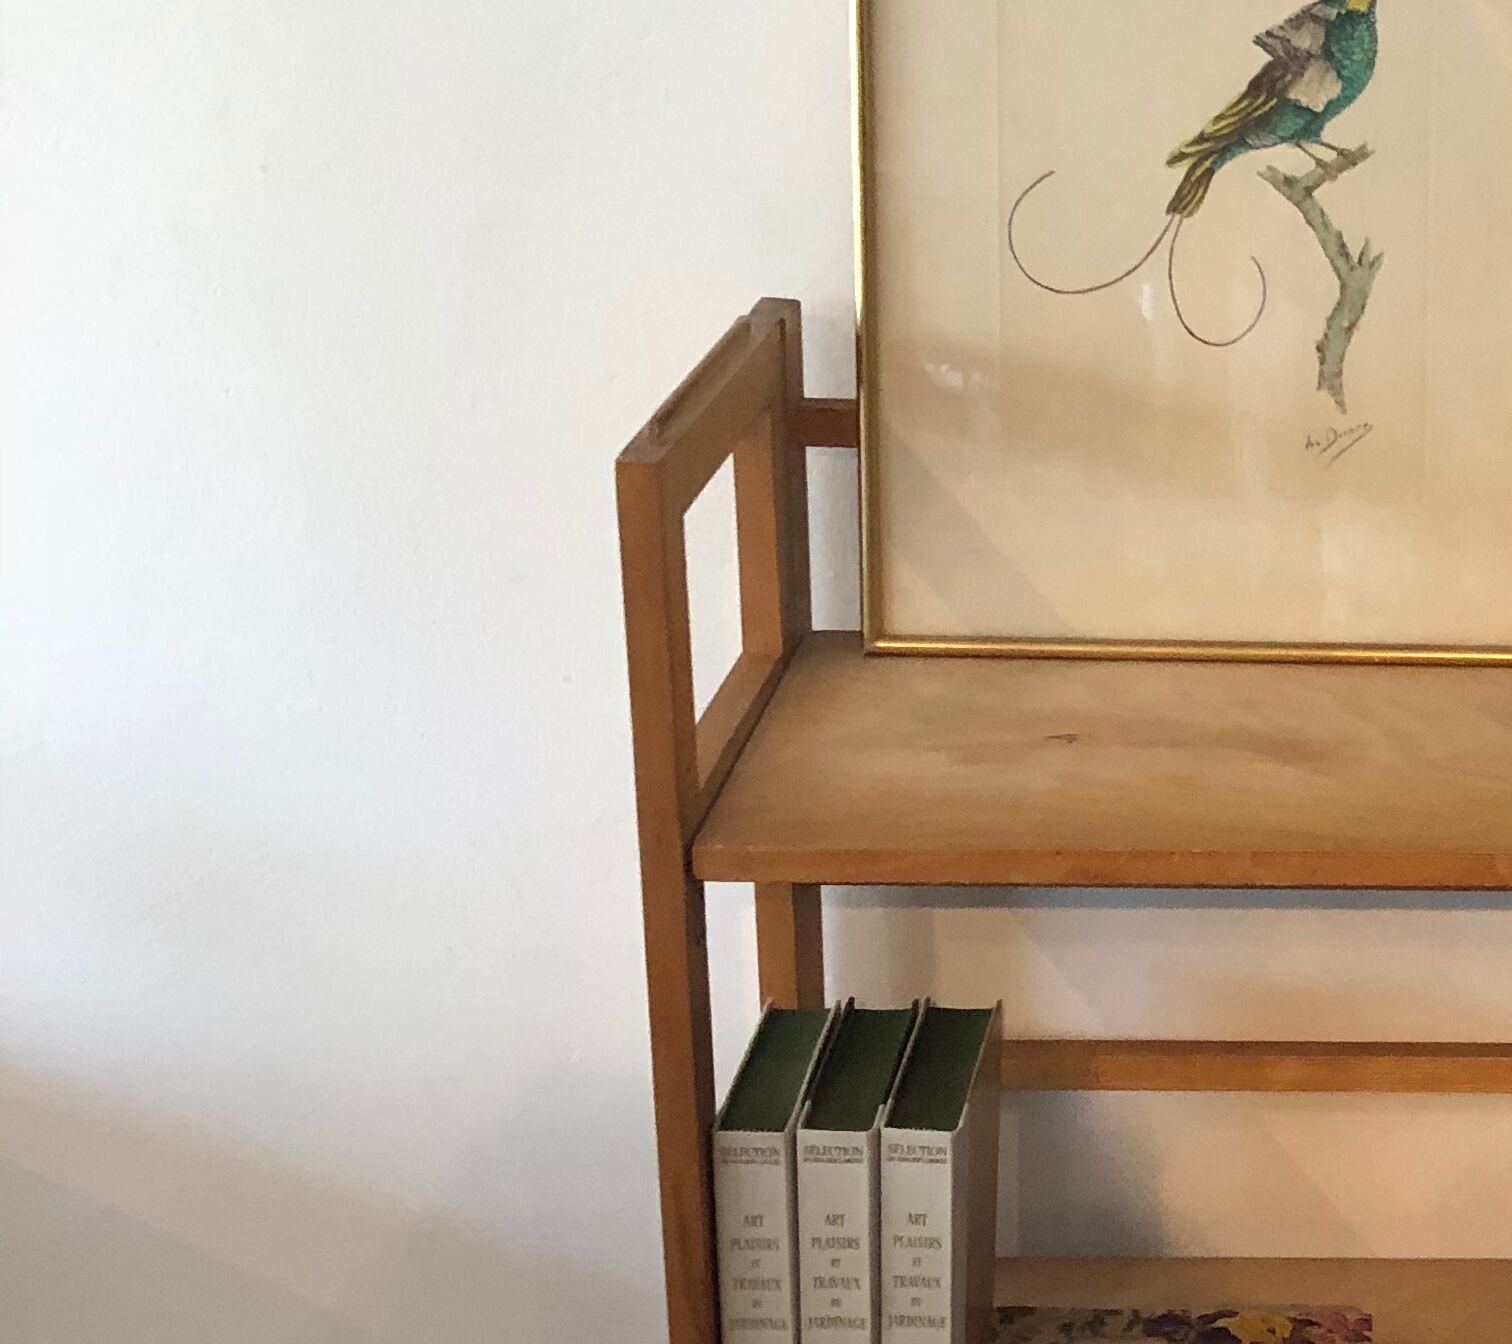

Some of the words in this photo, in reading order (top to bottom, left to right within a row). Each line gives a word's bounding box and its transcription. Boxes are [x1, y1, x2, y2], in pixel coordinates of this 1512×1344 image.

[742, 1214, 764, 1228] ART
[824, 1213, 846, 1228] ART
[906, 1212, 928, 1227] ART
[730, 1237, 780, 1252] PLAISIRS
[811, 1236, 861, 1251] PLAISIRS
[893, 1235, 943, 1250] PLAISIRS
[732, 1277, 782, 1291] TRAVAUX
[812, 1276, 861, 1290] TRAVAUX
[892, 1275, 942, 1290] TRAVAUX
